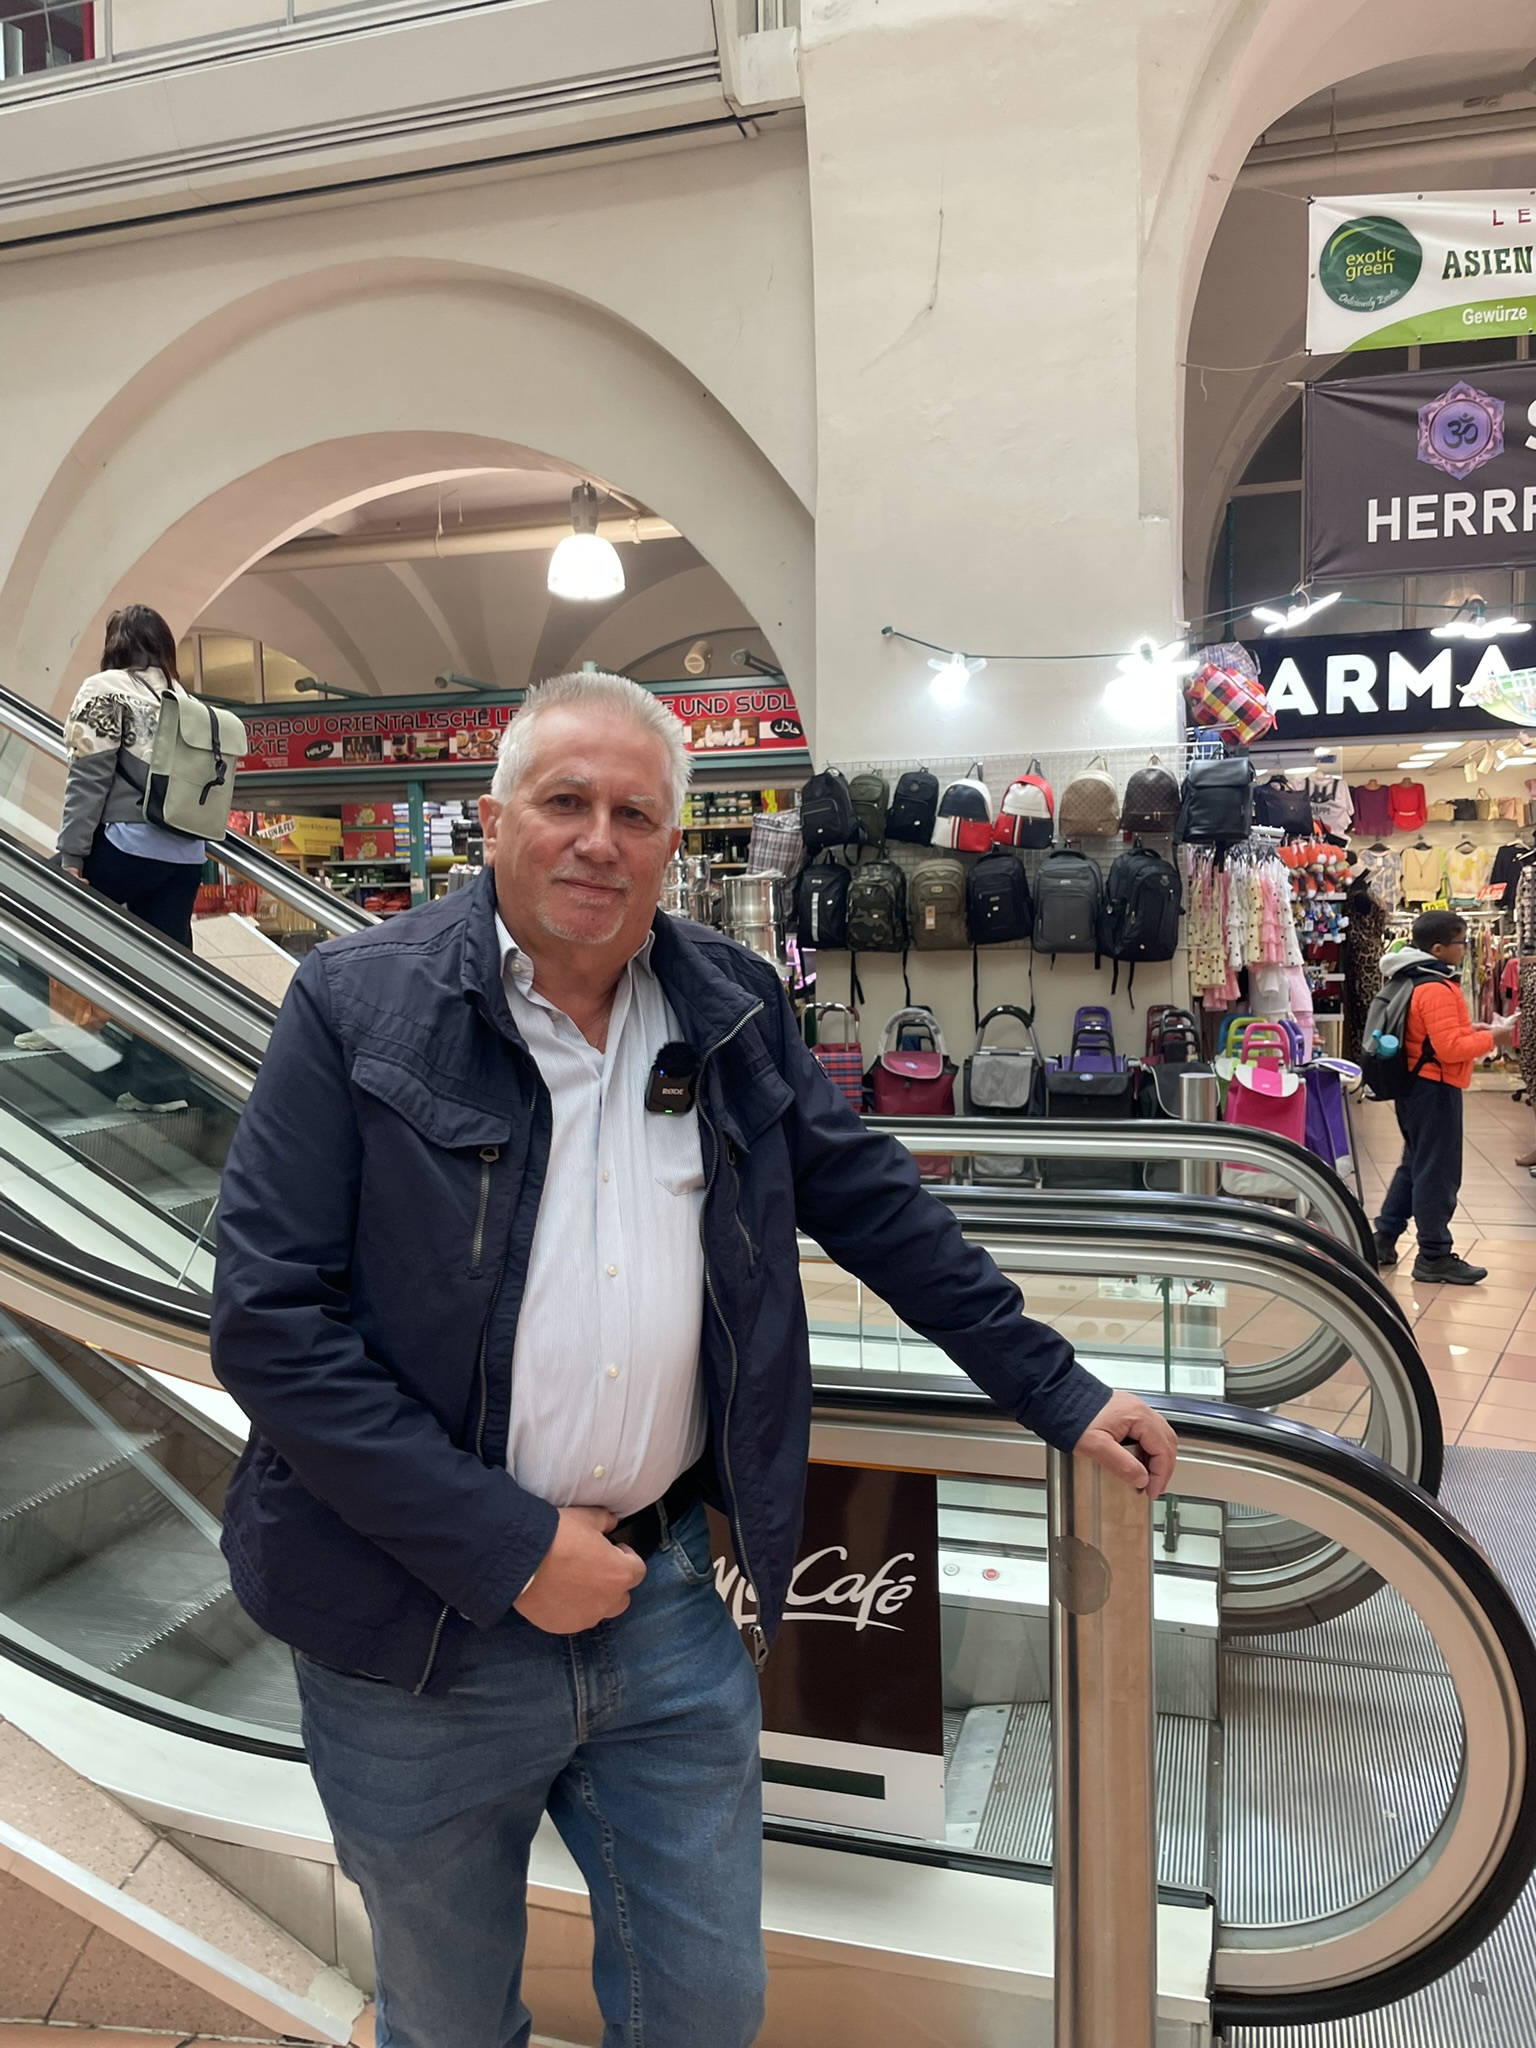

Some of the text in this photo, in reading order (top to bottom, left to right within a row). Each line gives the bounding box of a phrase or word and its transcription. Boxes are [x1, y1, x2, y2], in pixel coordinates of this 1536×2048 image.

[1345, 247, 1396, 267] exotic
[1441, 245, 1534, 281] ASIEN
[1345, 262, 1393, 282] green
[1462, 305, 1528, 326] Gewürze
[324, 707, 490, 734] ORIENTALISCHE
[680, 696, 729, 716] UND
[735, 690, 797, 715] SÜDL
[774, 719, 801, 735] حلال
[246, 738, 289, 757] KTE
[306, 743, 332, 758] HALAL
